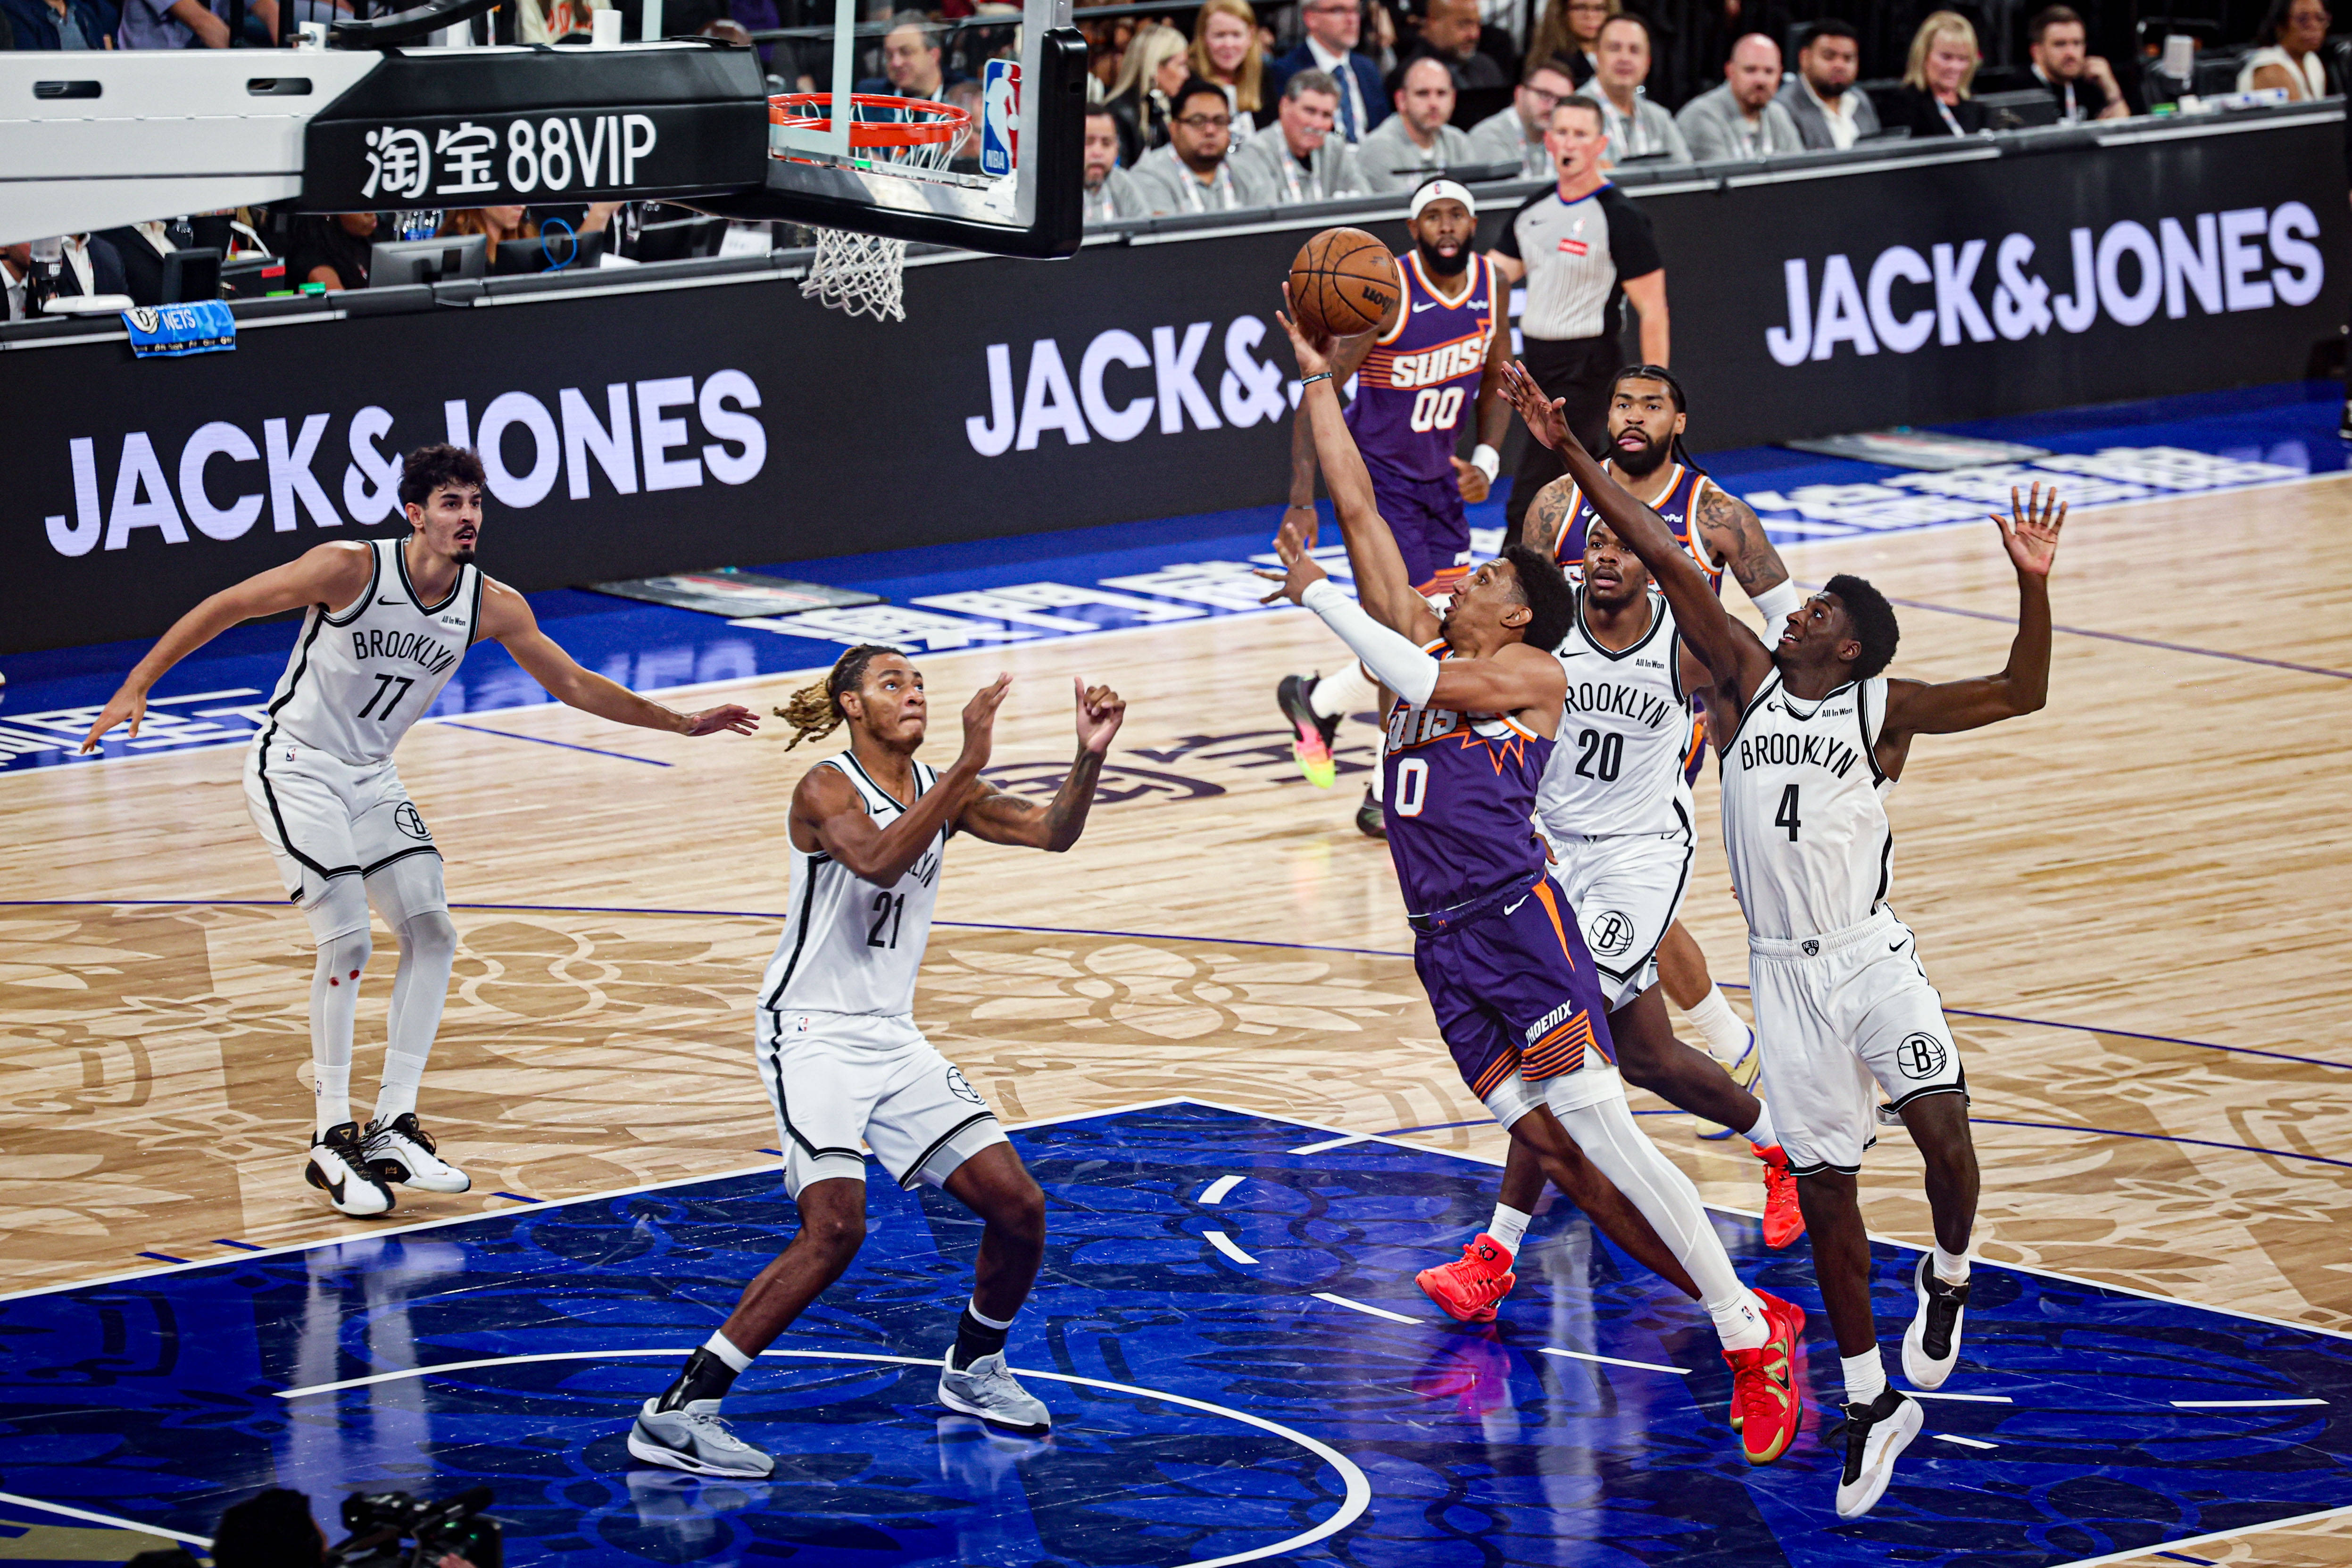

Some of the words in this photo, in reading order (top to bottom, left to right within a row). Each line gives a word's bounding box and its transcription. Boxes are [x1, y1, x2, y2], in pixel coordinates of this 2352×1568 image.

[987, 149, 1005, 169] NBA
[162, 308, 196, 331] NETS
[1410, 386, 1465, 433] 00
[449, 616, 454, 624] In
[455, 617, 466, 627] Won
[352, 629, 457, 676] BROOKLYN
[1636, 658, 1644, 667] All
[1645, 659, 1651, 668] In
[1652, 660, 1664, 669] Won
[357, 673, 416, 721] 77
[1564, 682, 1670, 729] ROOKLYN
[1822, 709, 1830, 718] All
[1832, 709, 1838, 717] In
[1839, 707, 1853, 715] Won
[1575, 729, 1624, 782] 20
[1741, 733, 1859, 780] BROOKLYN
[1395, 757, 1429, 817] 0
[1775, 784, 1801, 842] 4
[866, 891, 906, 949] 21
[1599, 917, 1621, 949] B
[1803, 941, 1819, 950] NETS
[1911, 1040, 1932, 1073] B
